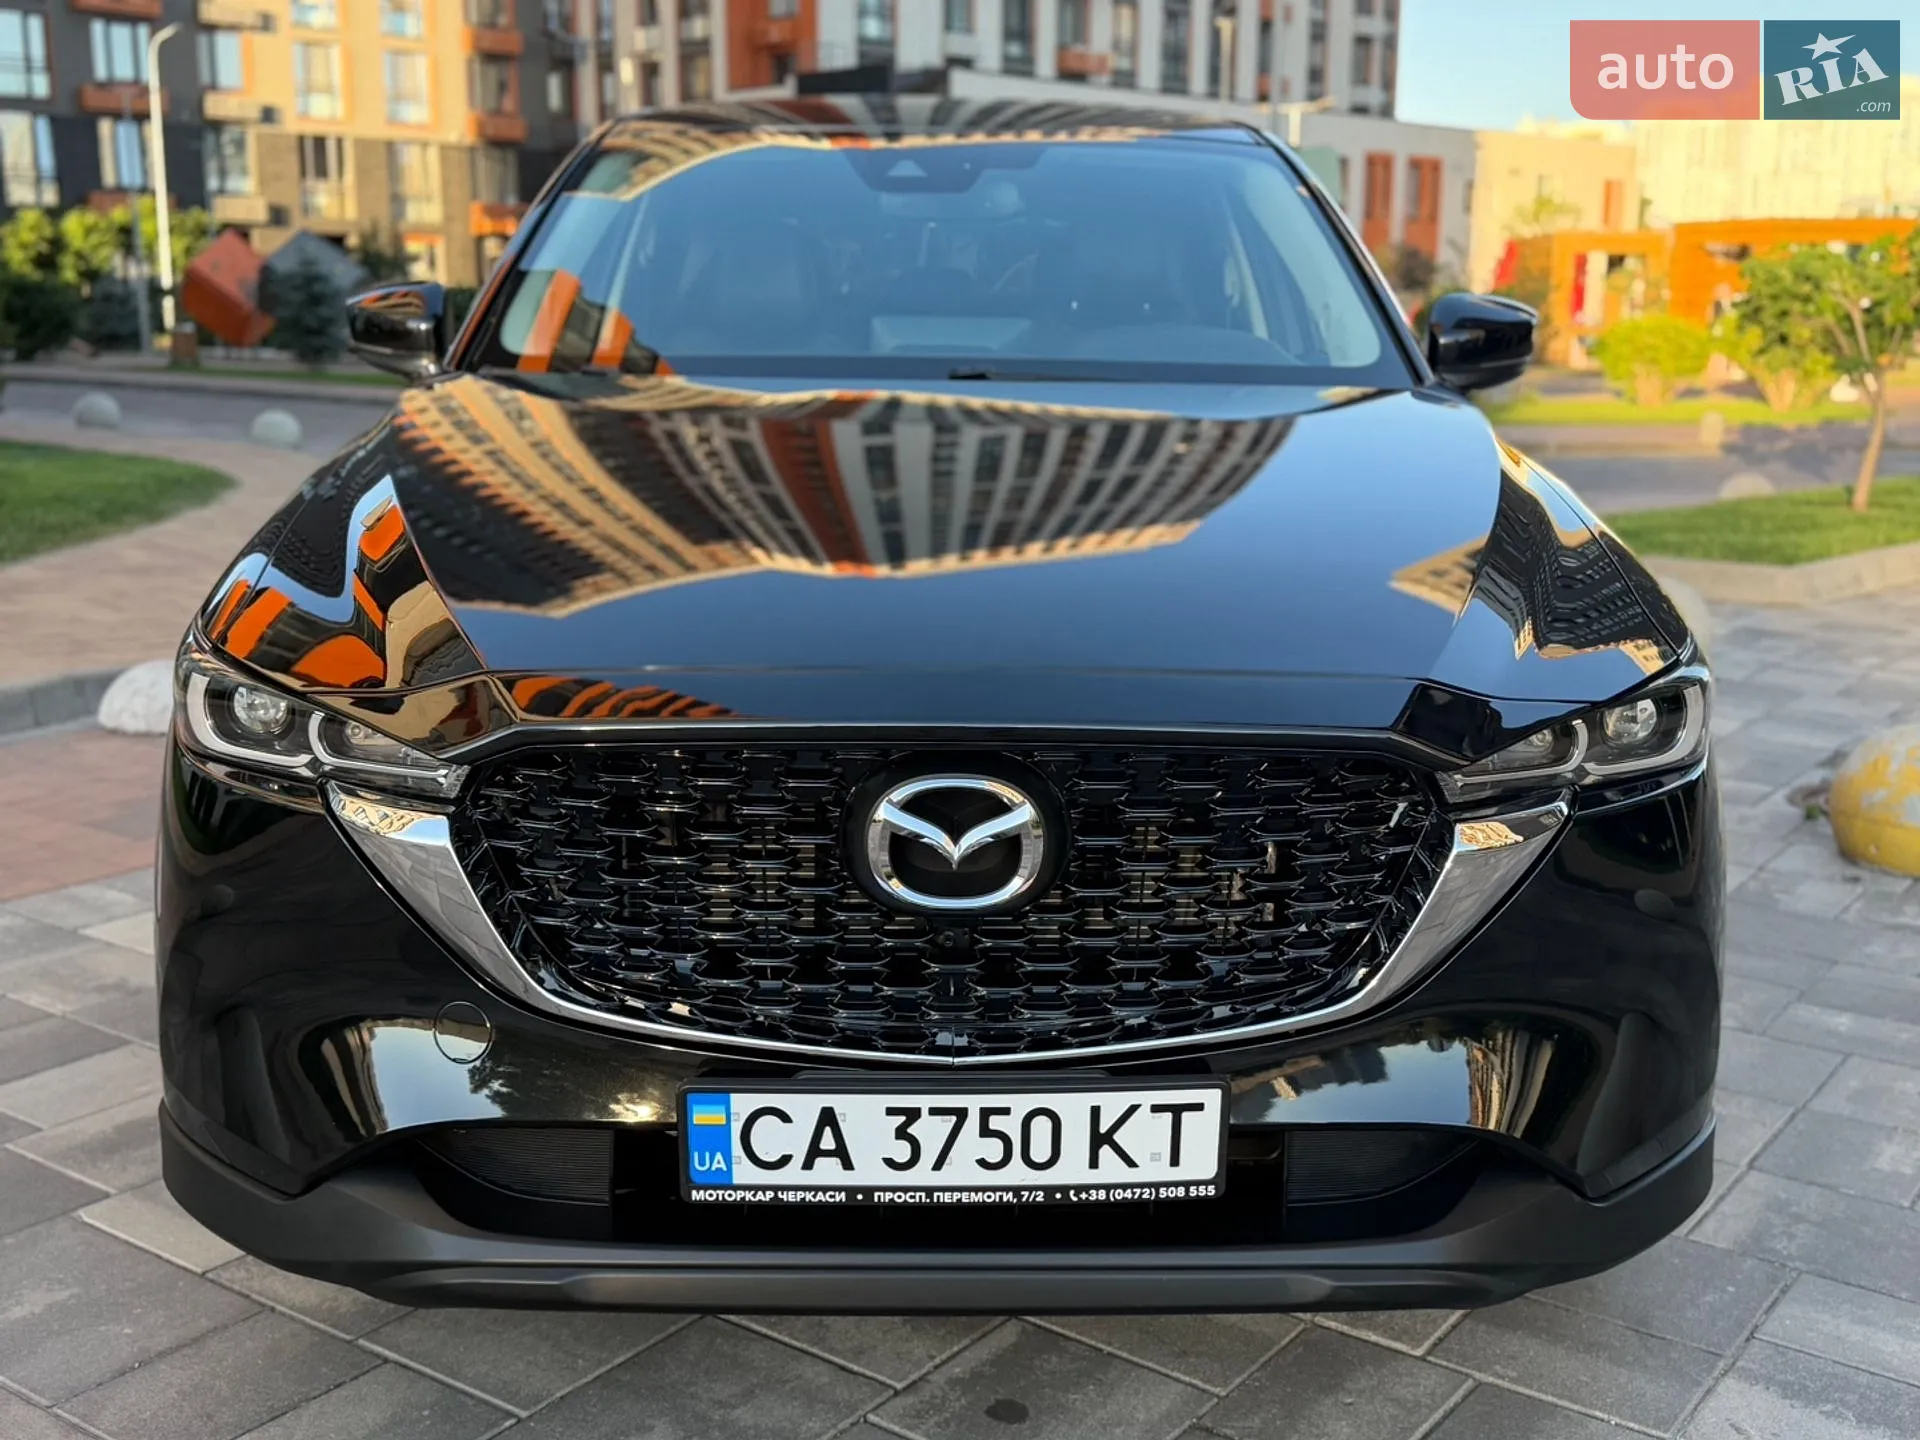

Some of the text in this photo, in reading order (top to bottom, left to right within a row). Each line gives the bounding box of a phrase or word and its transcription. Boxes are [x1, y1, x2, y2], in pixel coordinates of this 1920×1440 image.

[739, 1102, 1205, 1172] CA 3750 KT
[693, 1151, 728, 1171] UA
[691, 1189, 846, 1203] МОТОРКАР ЧЕРКАСИ
[874, 1190, 1045, 1204] ПРОСП. ПЕРЕМОГИ, 7/2
[1079, 1184, 1216, 1201] +38 (0472) 508 555
